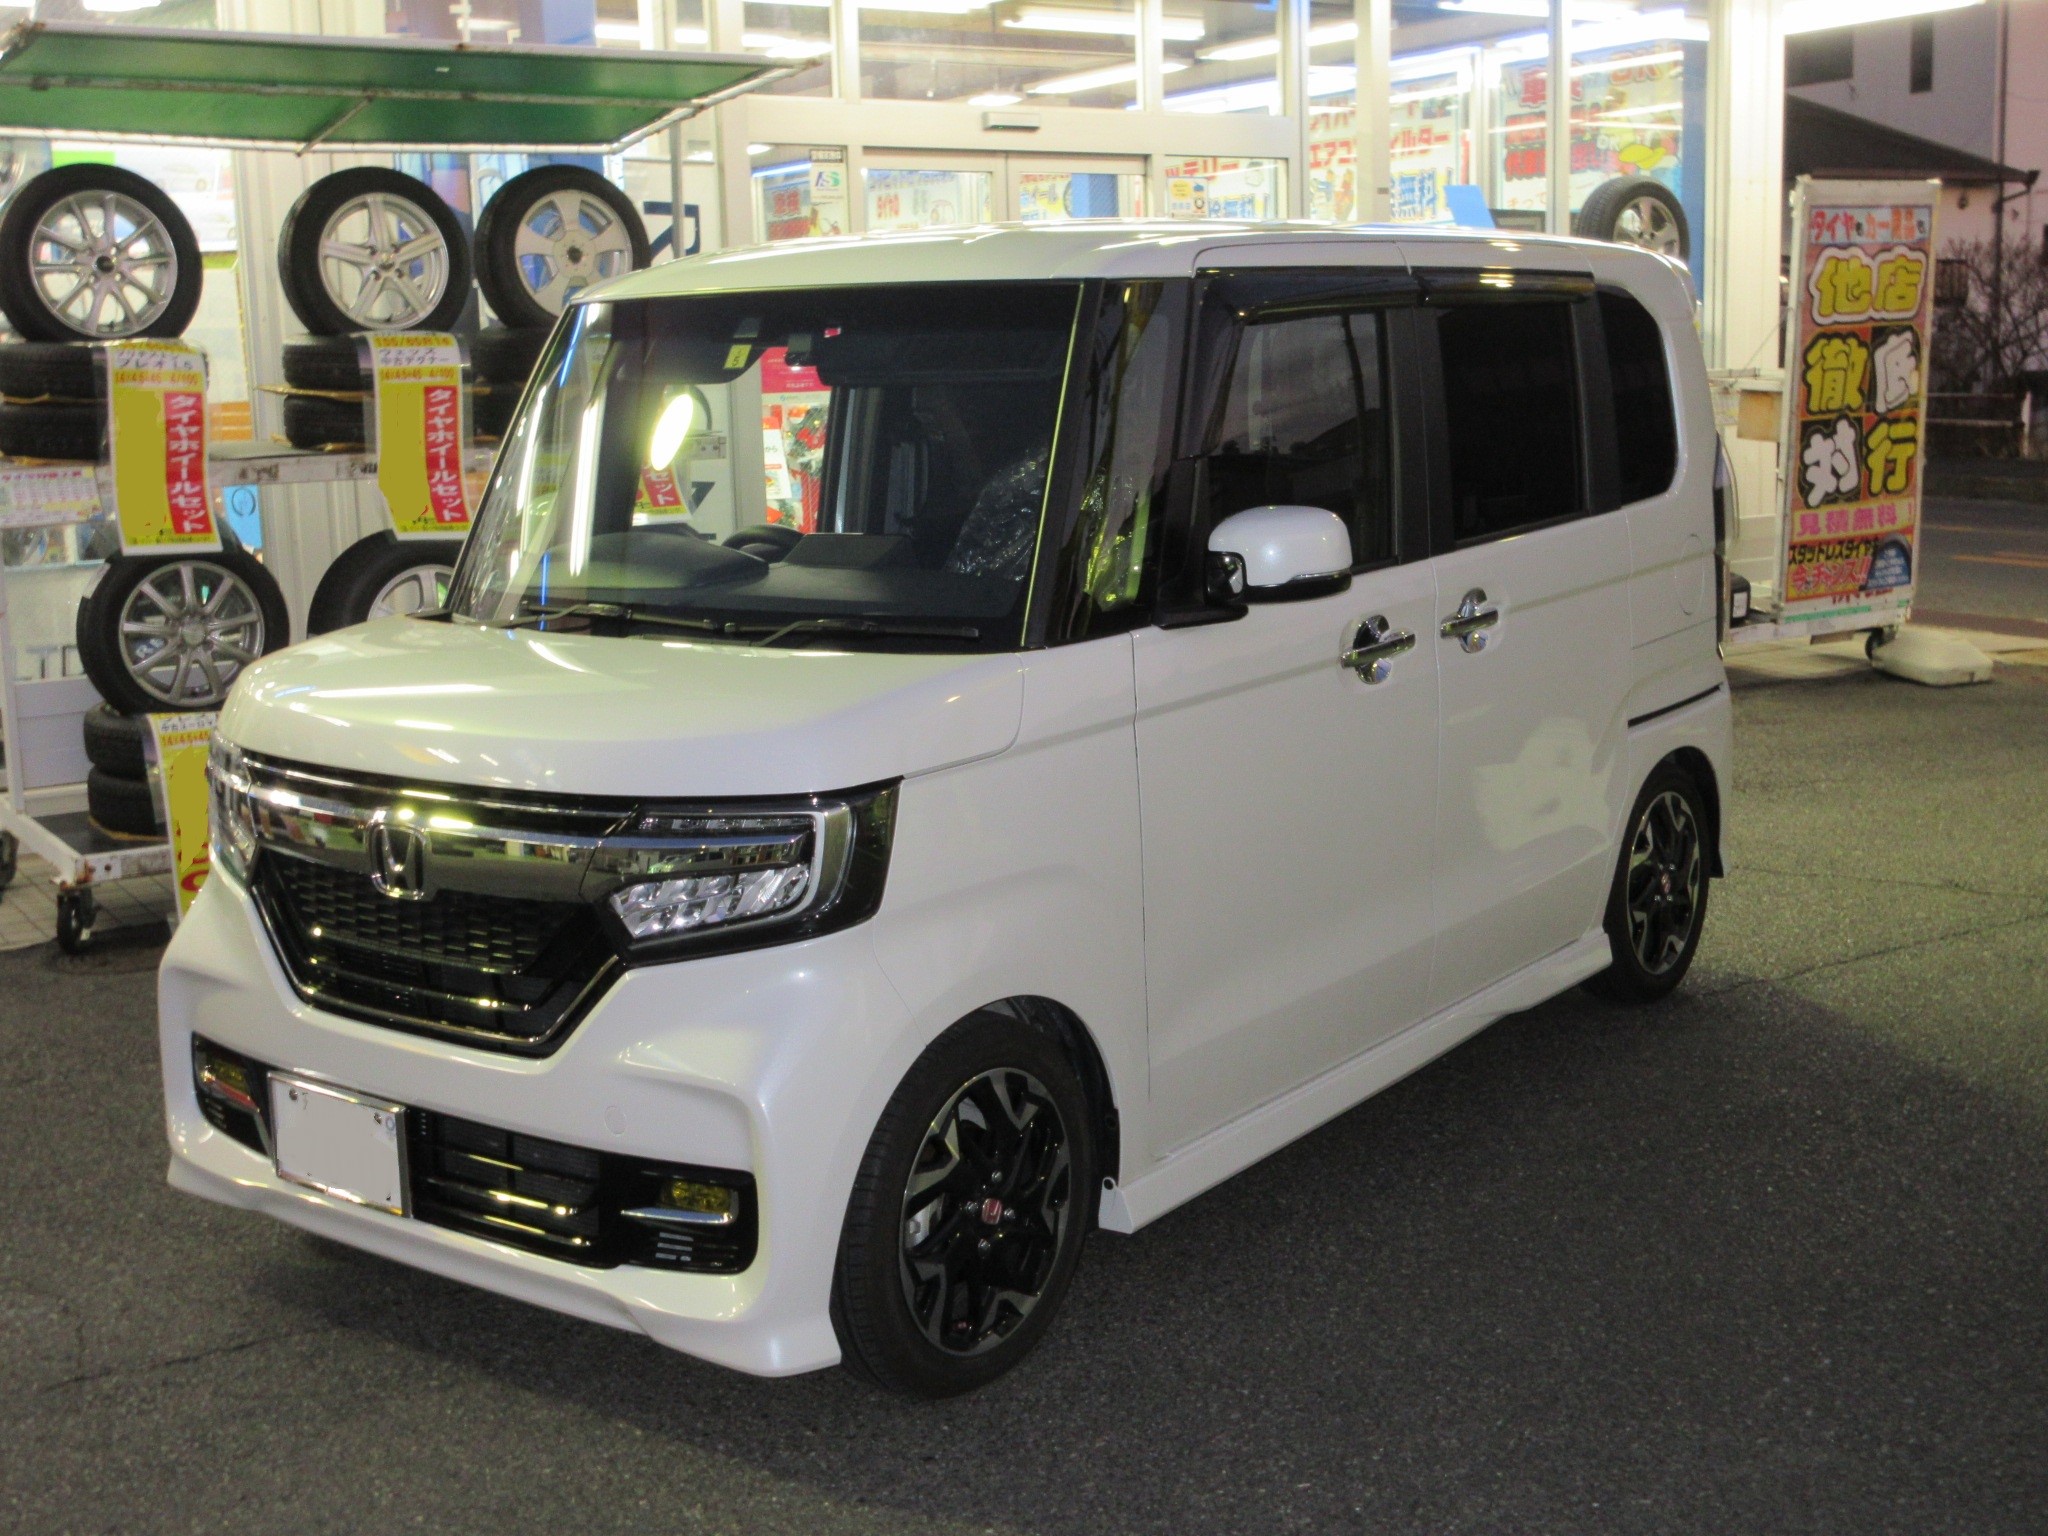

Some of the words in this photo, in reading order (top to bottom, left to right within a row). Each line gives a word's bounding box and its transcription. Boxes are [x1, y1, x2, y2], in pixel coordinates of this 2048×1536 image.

[1814, 253, 1924, 319] 他店
[1805, 330, 1920, 414] 徹底
[168, 394, 206, 534] タイヤホイールセット
[426, 388, 463, 523] タイヤホイールセット
